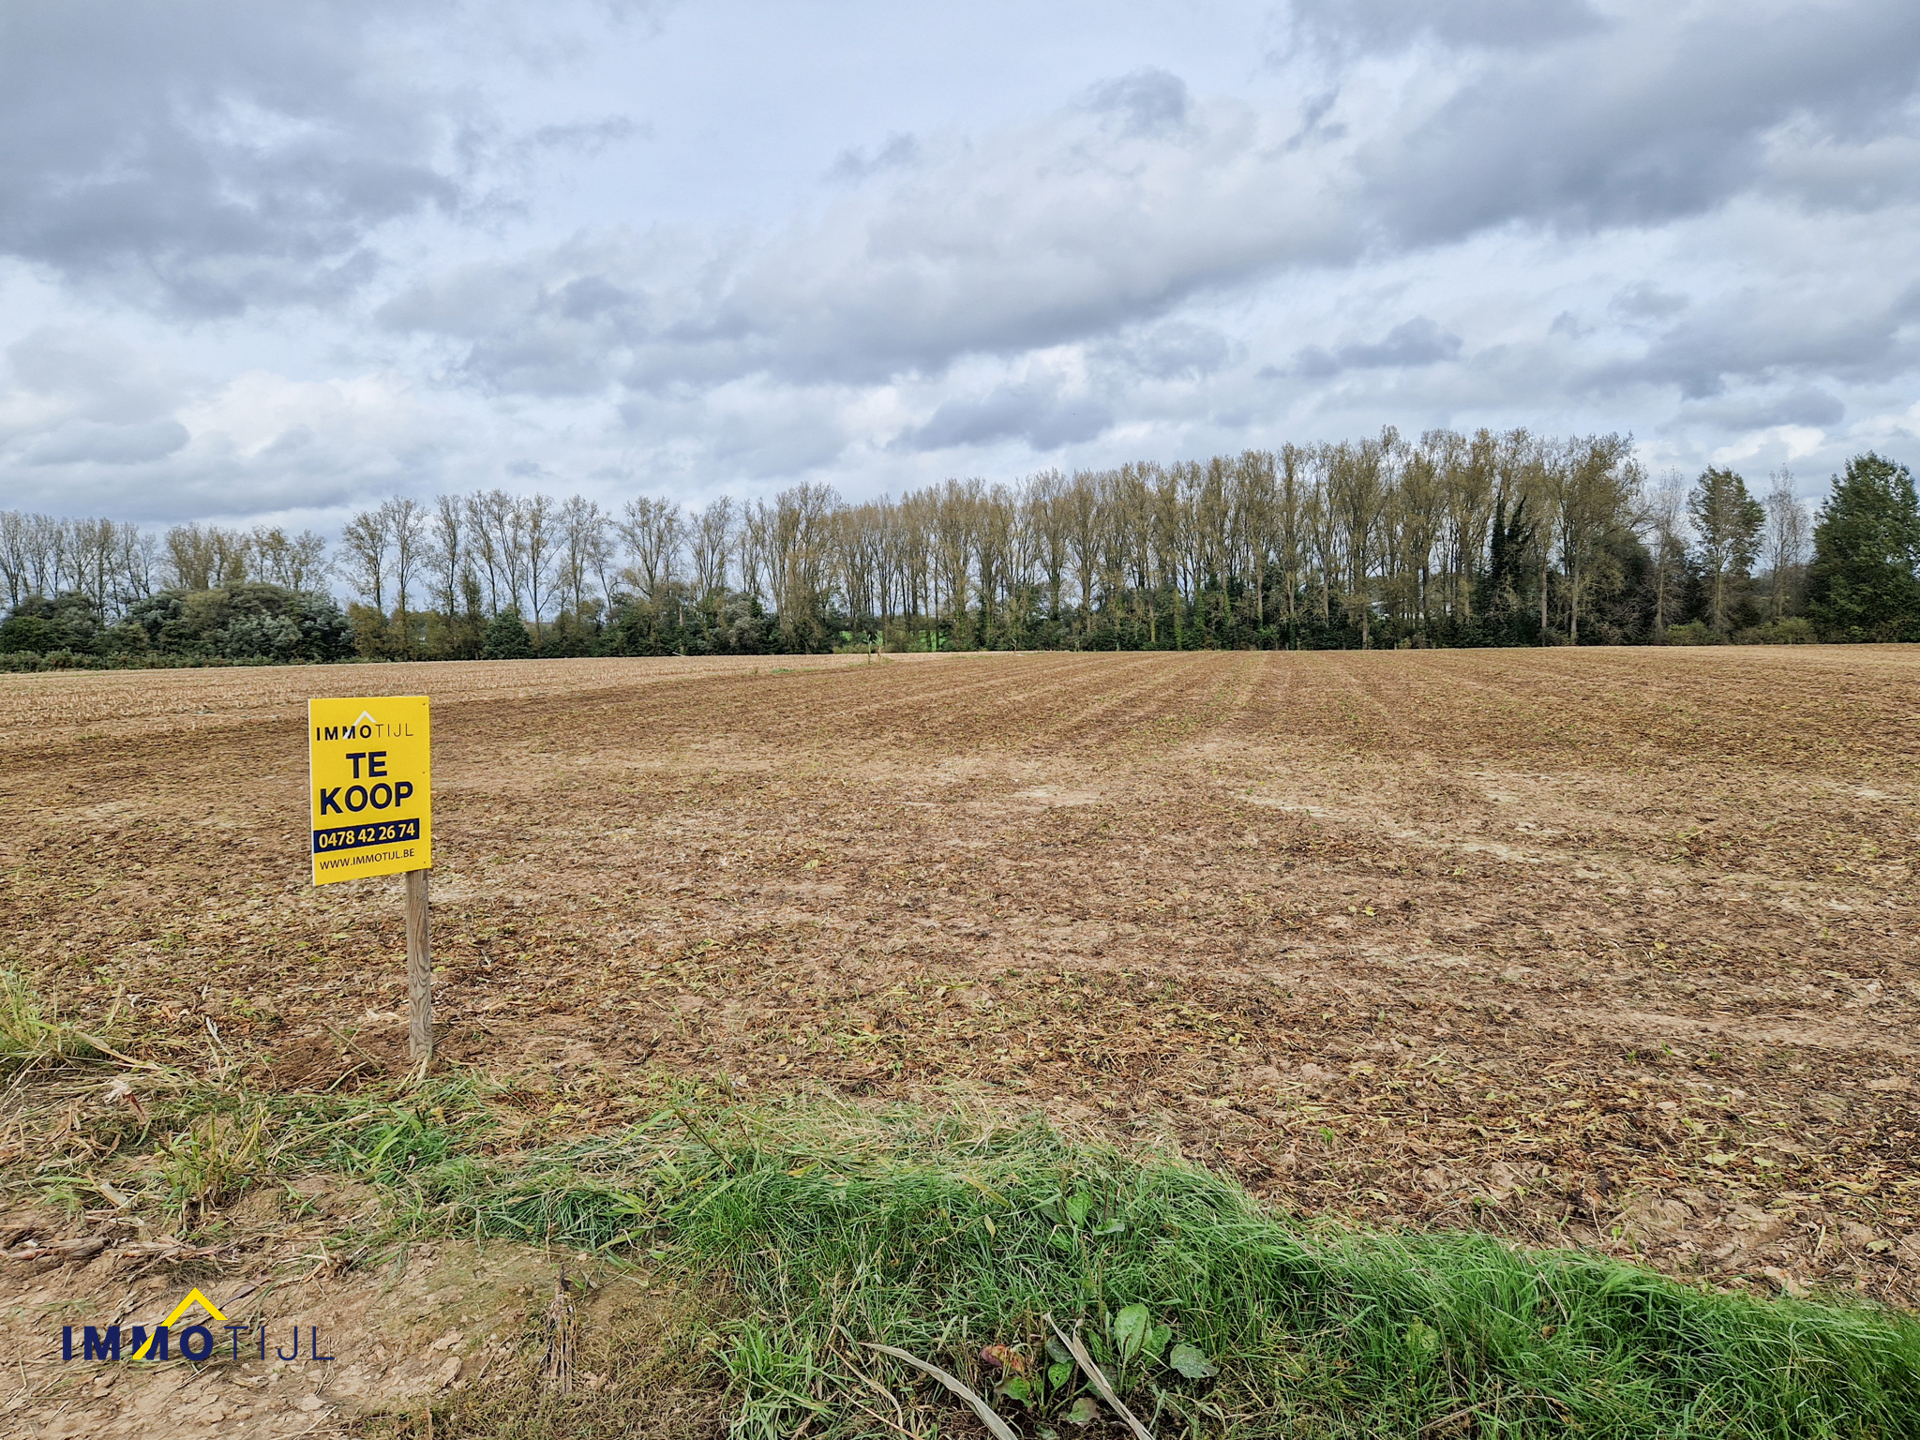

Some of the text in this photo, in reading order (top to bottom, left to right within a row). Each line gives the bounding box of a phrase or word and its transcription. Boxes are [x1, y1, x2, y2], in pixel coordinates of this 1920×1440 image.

[316, 723, 414, 741] IMMOTIJL
[345, 751, 388, 779] TE
[320, 781, 414, 816] KOOP
[318, 822, 416, 849] 0478 42 26 74
[319, 848, 415, 870] WWW.IMMOTIJL.BE
